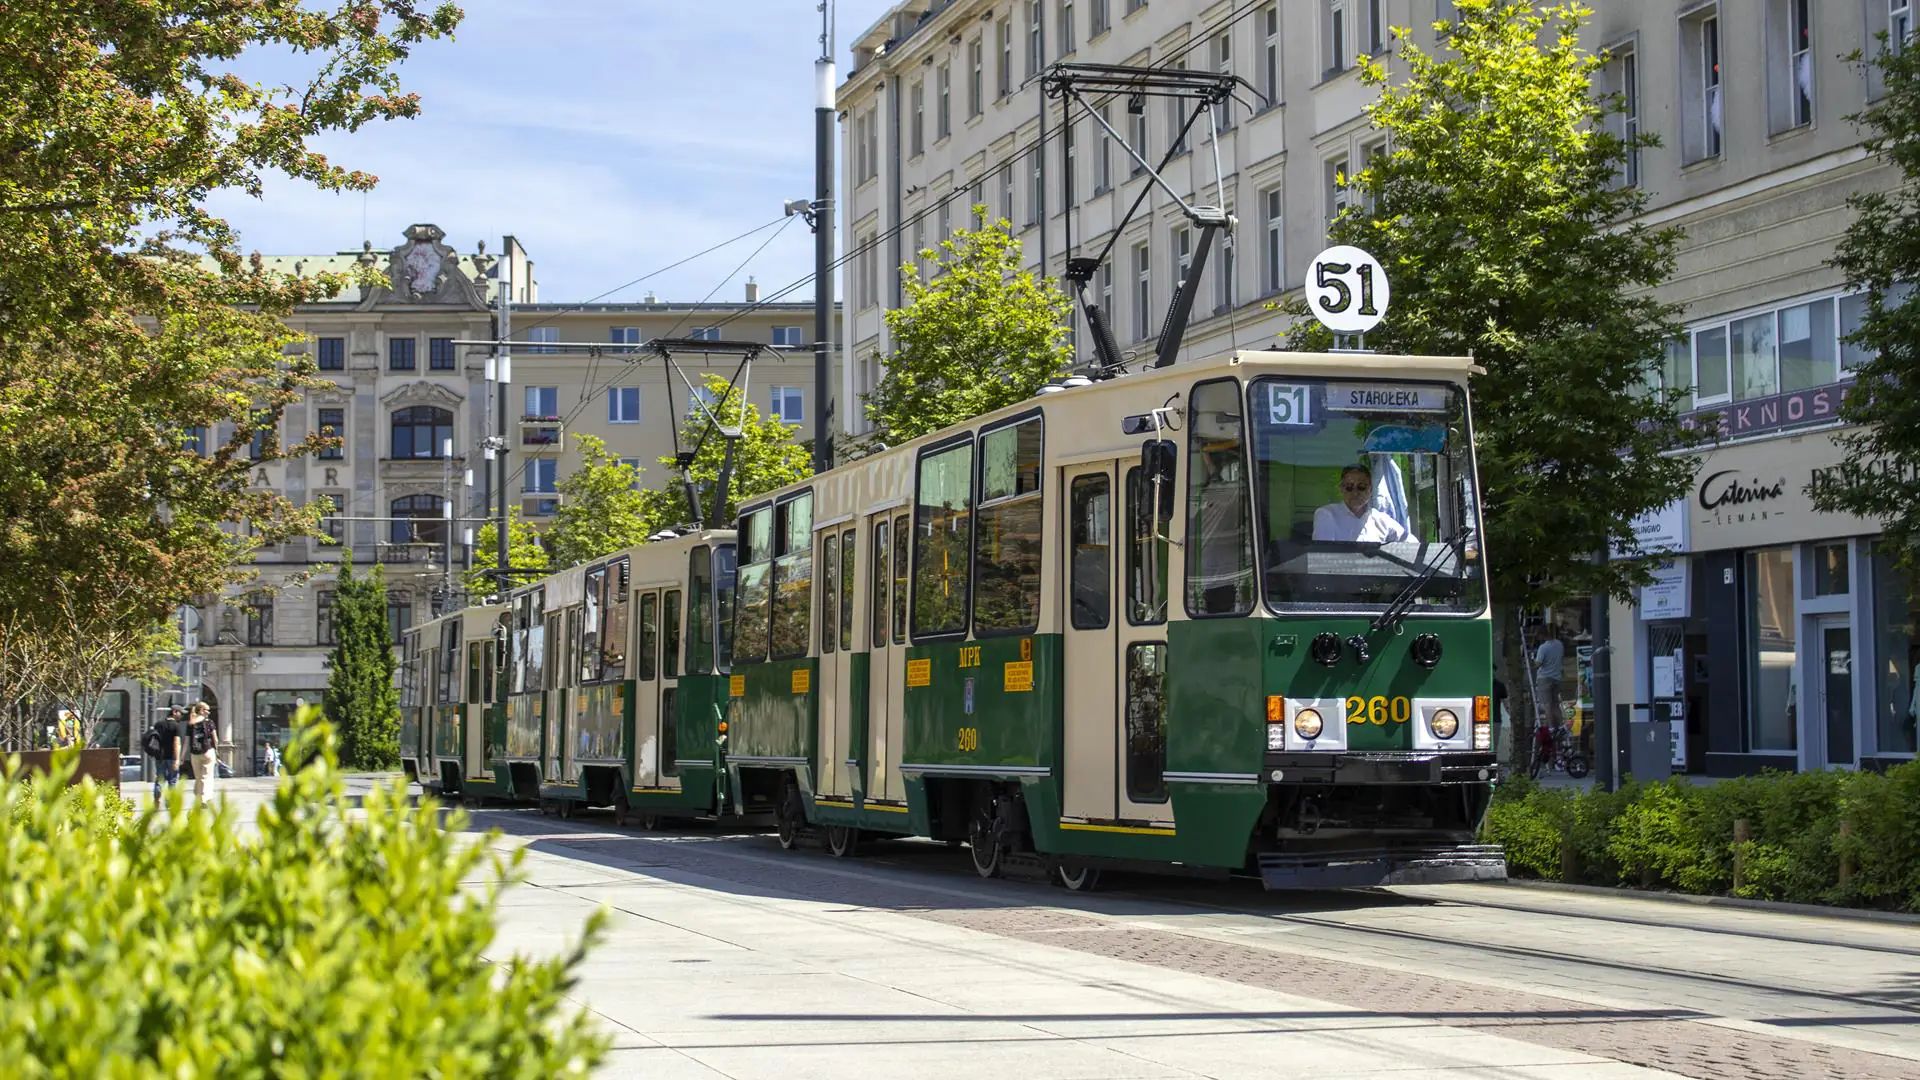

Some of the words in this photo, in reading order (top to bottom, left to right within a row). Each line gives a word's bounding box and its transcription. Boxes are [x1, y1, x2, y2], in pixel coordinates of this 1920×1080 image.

[1316, 261, 1378, 316] 51
[1272, 386, 1305, 423] 51
[1717, 511, 1768, 525] LEMAN
[958, 646, 982, 668] MPK
[1346, 695, 1412, 726] 260
[958, 727, 977, 752] 260
